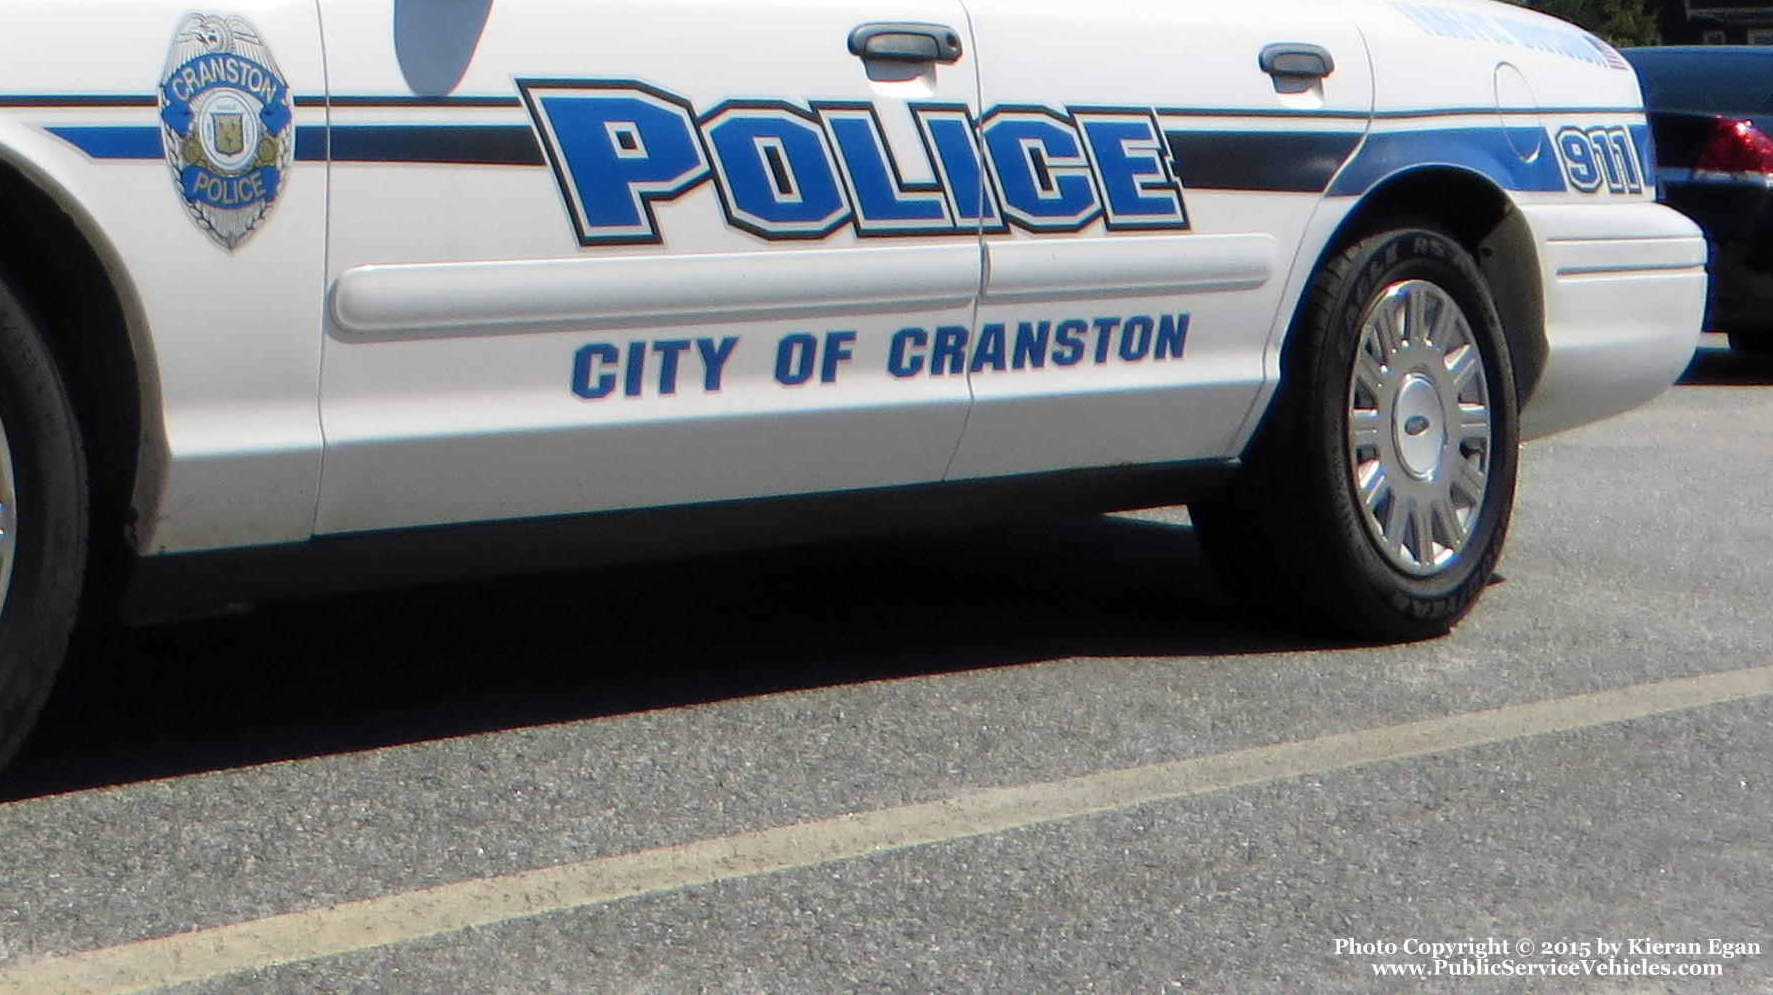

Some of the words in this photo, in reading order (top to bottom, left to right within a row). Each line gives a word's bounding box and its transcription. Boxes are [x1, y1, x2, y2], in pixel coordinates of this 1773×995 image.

[172, 57, 276, 104] CRANSTON
[194, 171, 266, 206] POLICE
[515, 75, 1193, 247] POLICE
[1553, 124, 1644, 195] 911
[571, 334, 739, 400] CITY
[773, 329, 858, 387] OF
[885, 312, 1192, 380] CRANSTON
